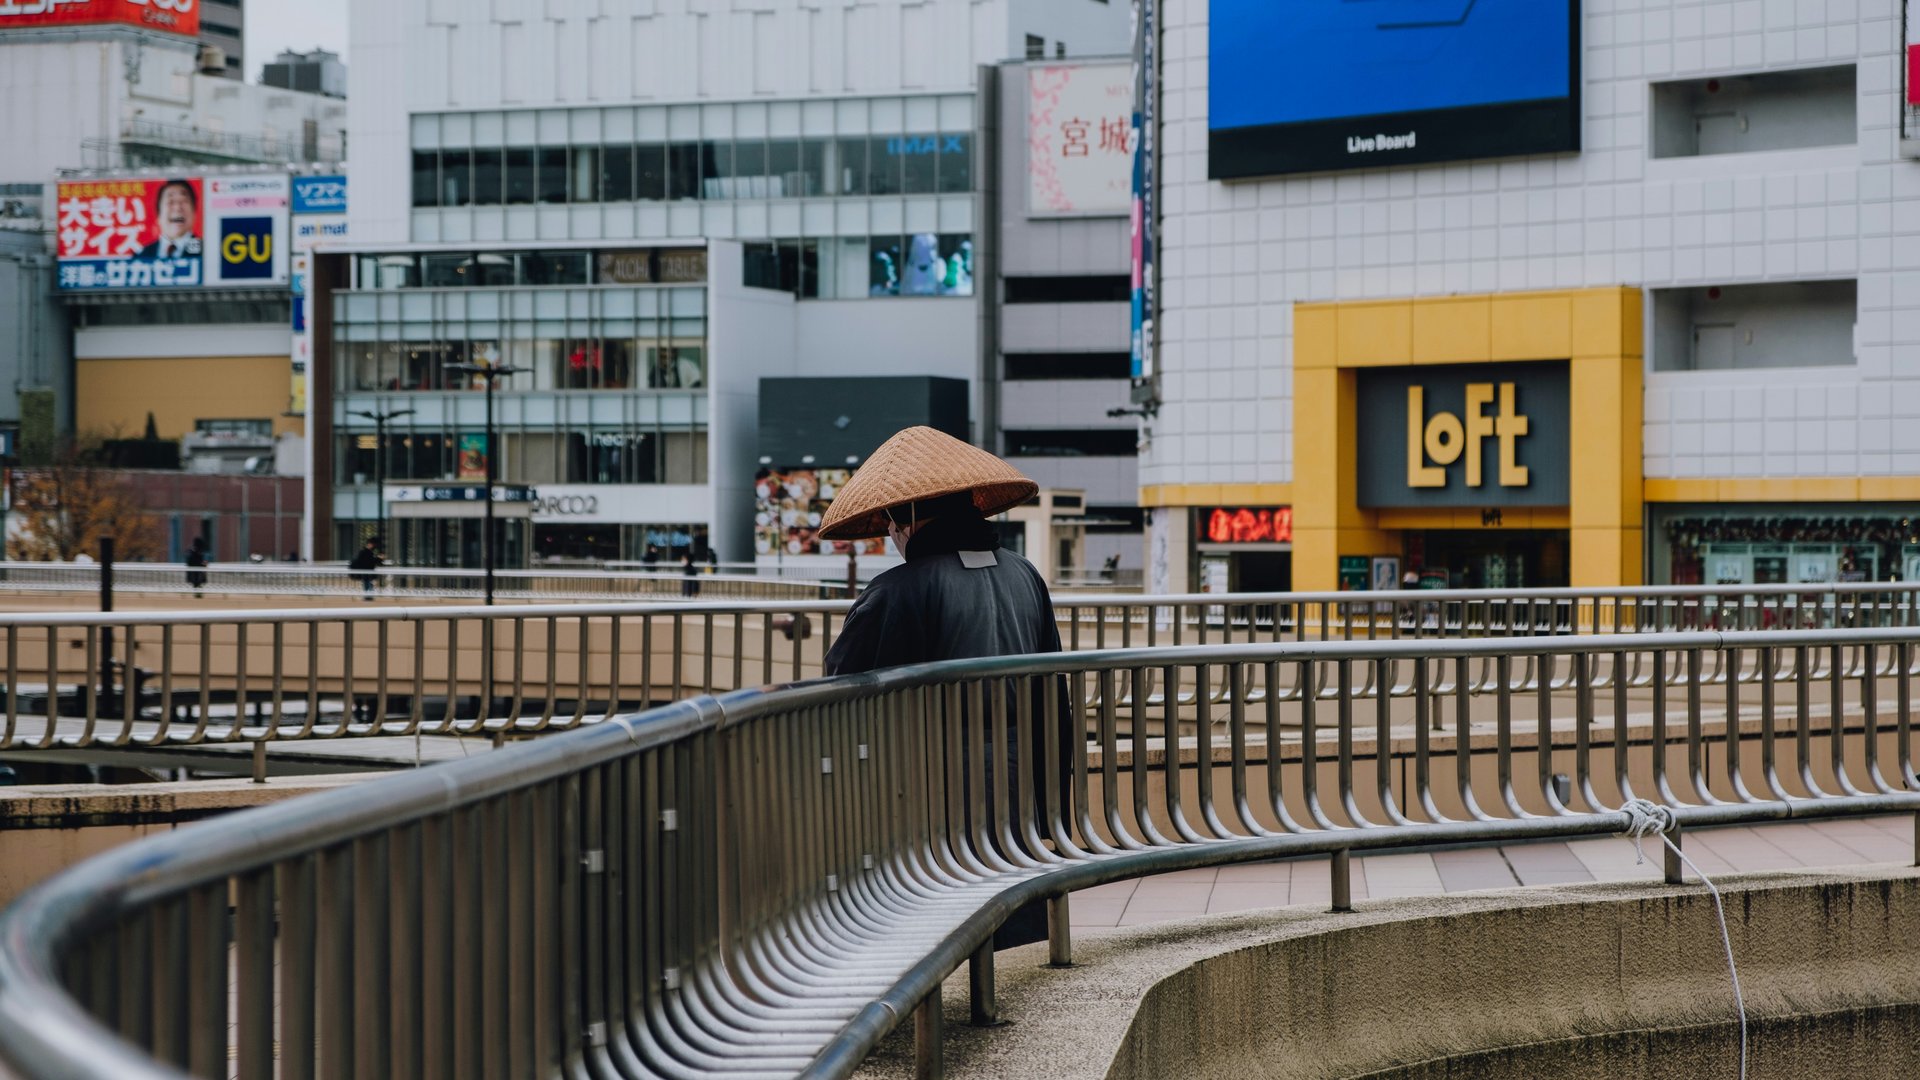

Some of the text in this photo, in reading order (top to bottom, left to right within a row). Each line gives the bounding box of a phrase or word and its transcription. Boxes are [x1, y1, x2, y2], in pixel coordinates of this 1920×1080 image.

[887, 134, 963, 155] IMAX
[1347, 130, 1416, 153] Live Board
[60, 197, 146, 227] 大きい
[60, 224, 146, 256] サイズ
[222, 232, 272, 264] GU
